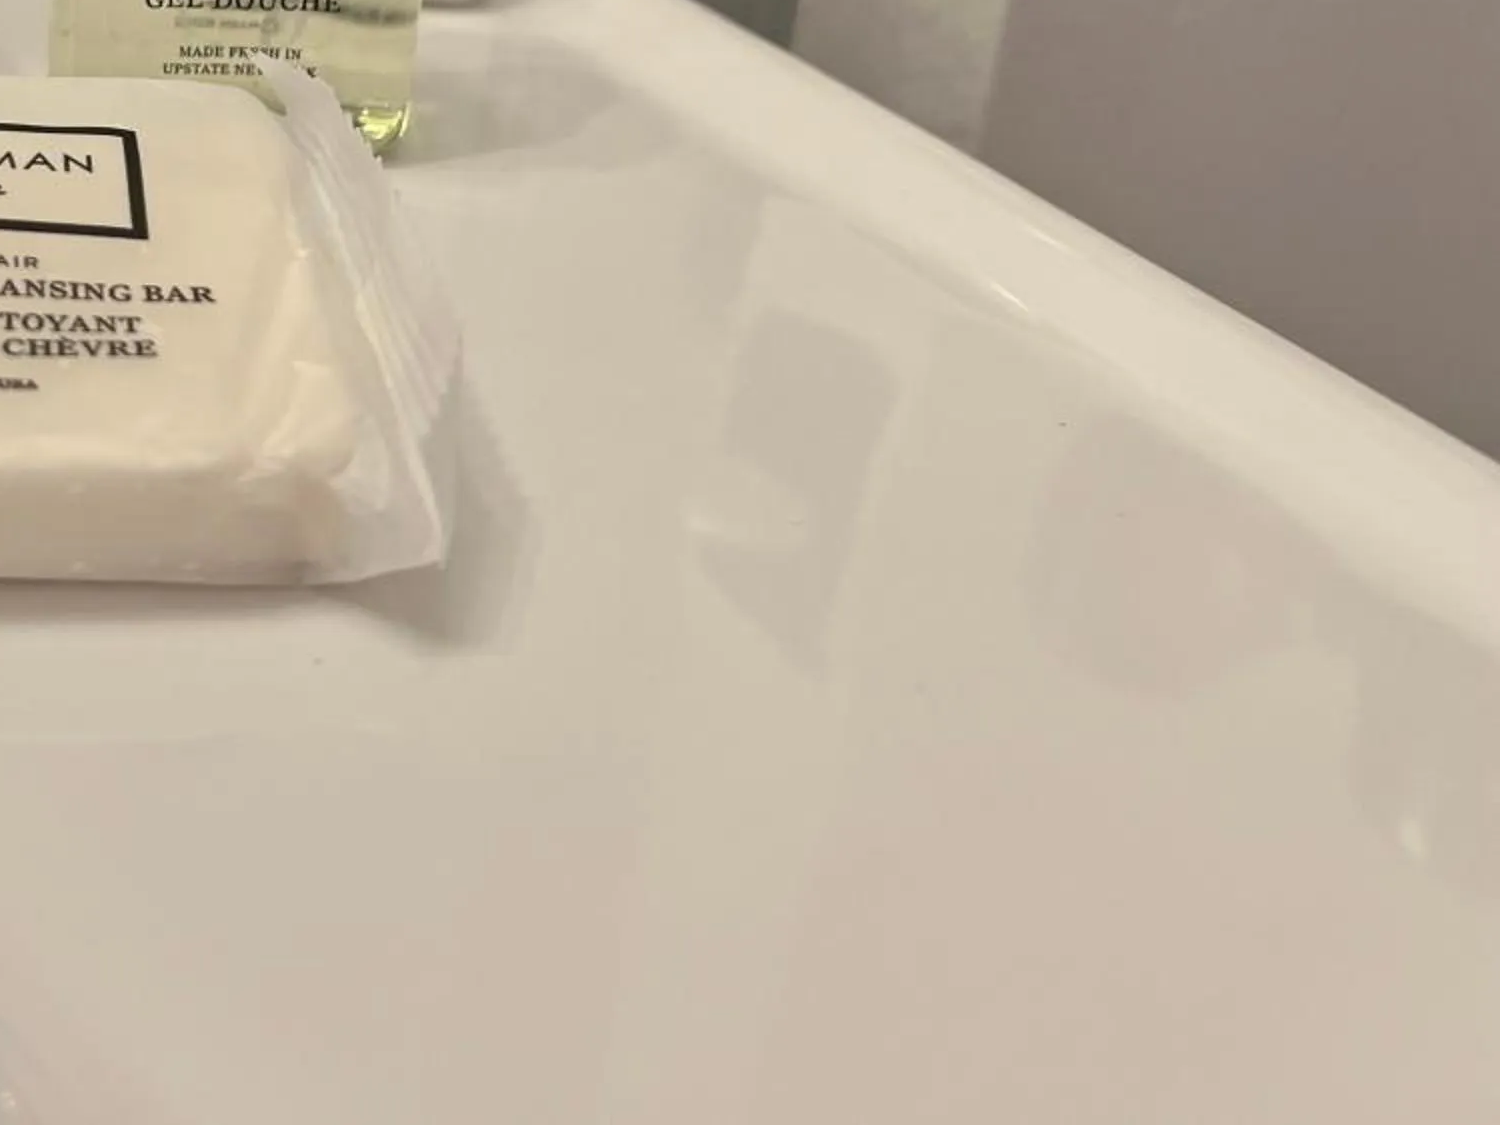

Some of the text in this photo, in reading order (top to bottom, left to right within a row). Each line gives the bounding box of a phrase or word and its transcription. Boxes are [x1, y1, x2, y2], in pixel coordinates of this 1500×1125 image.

[179, 45, 225, 59] MADE
[285, 47, 302, 61] IN
[163, 62, 228, 76] UPSTATE
[142, 284, 217, 304] BAR
[2, 334, 157, 358] CHÈVRE
